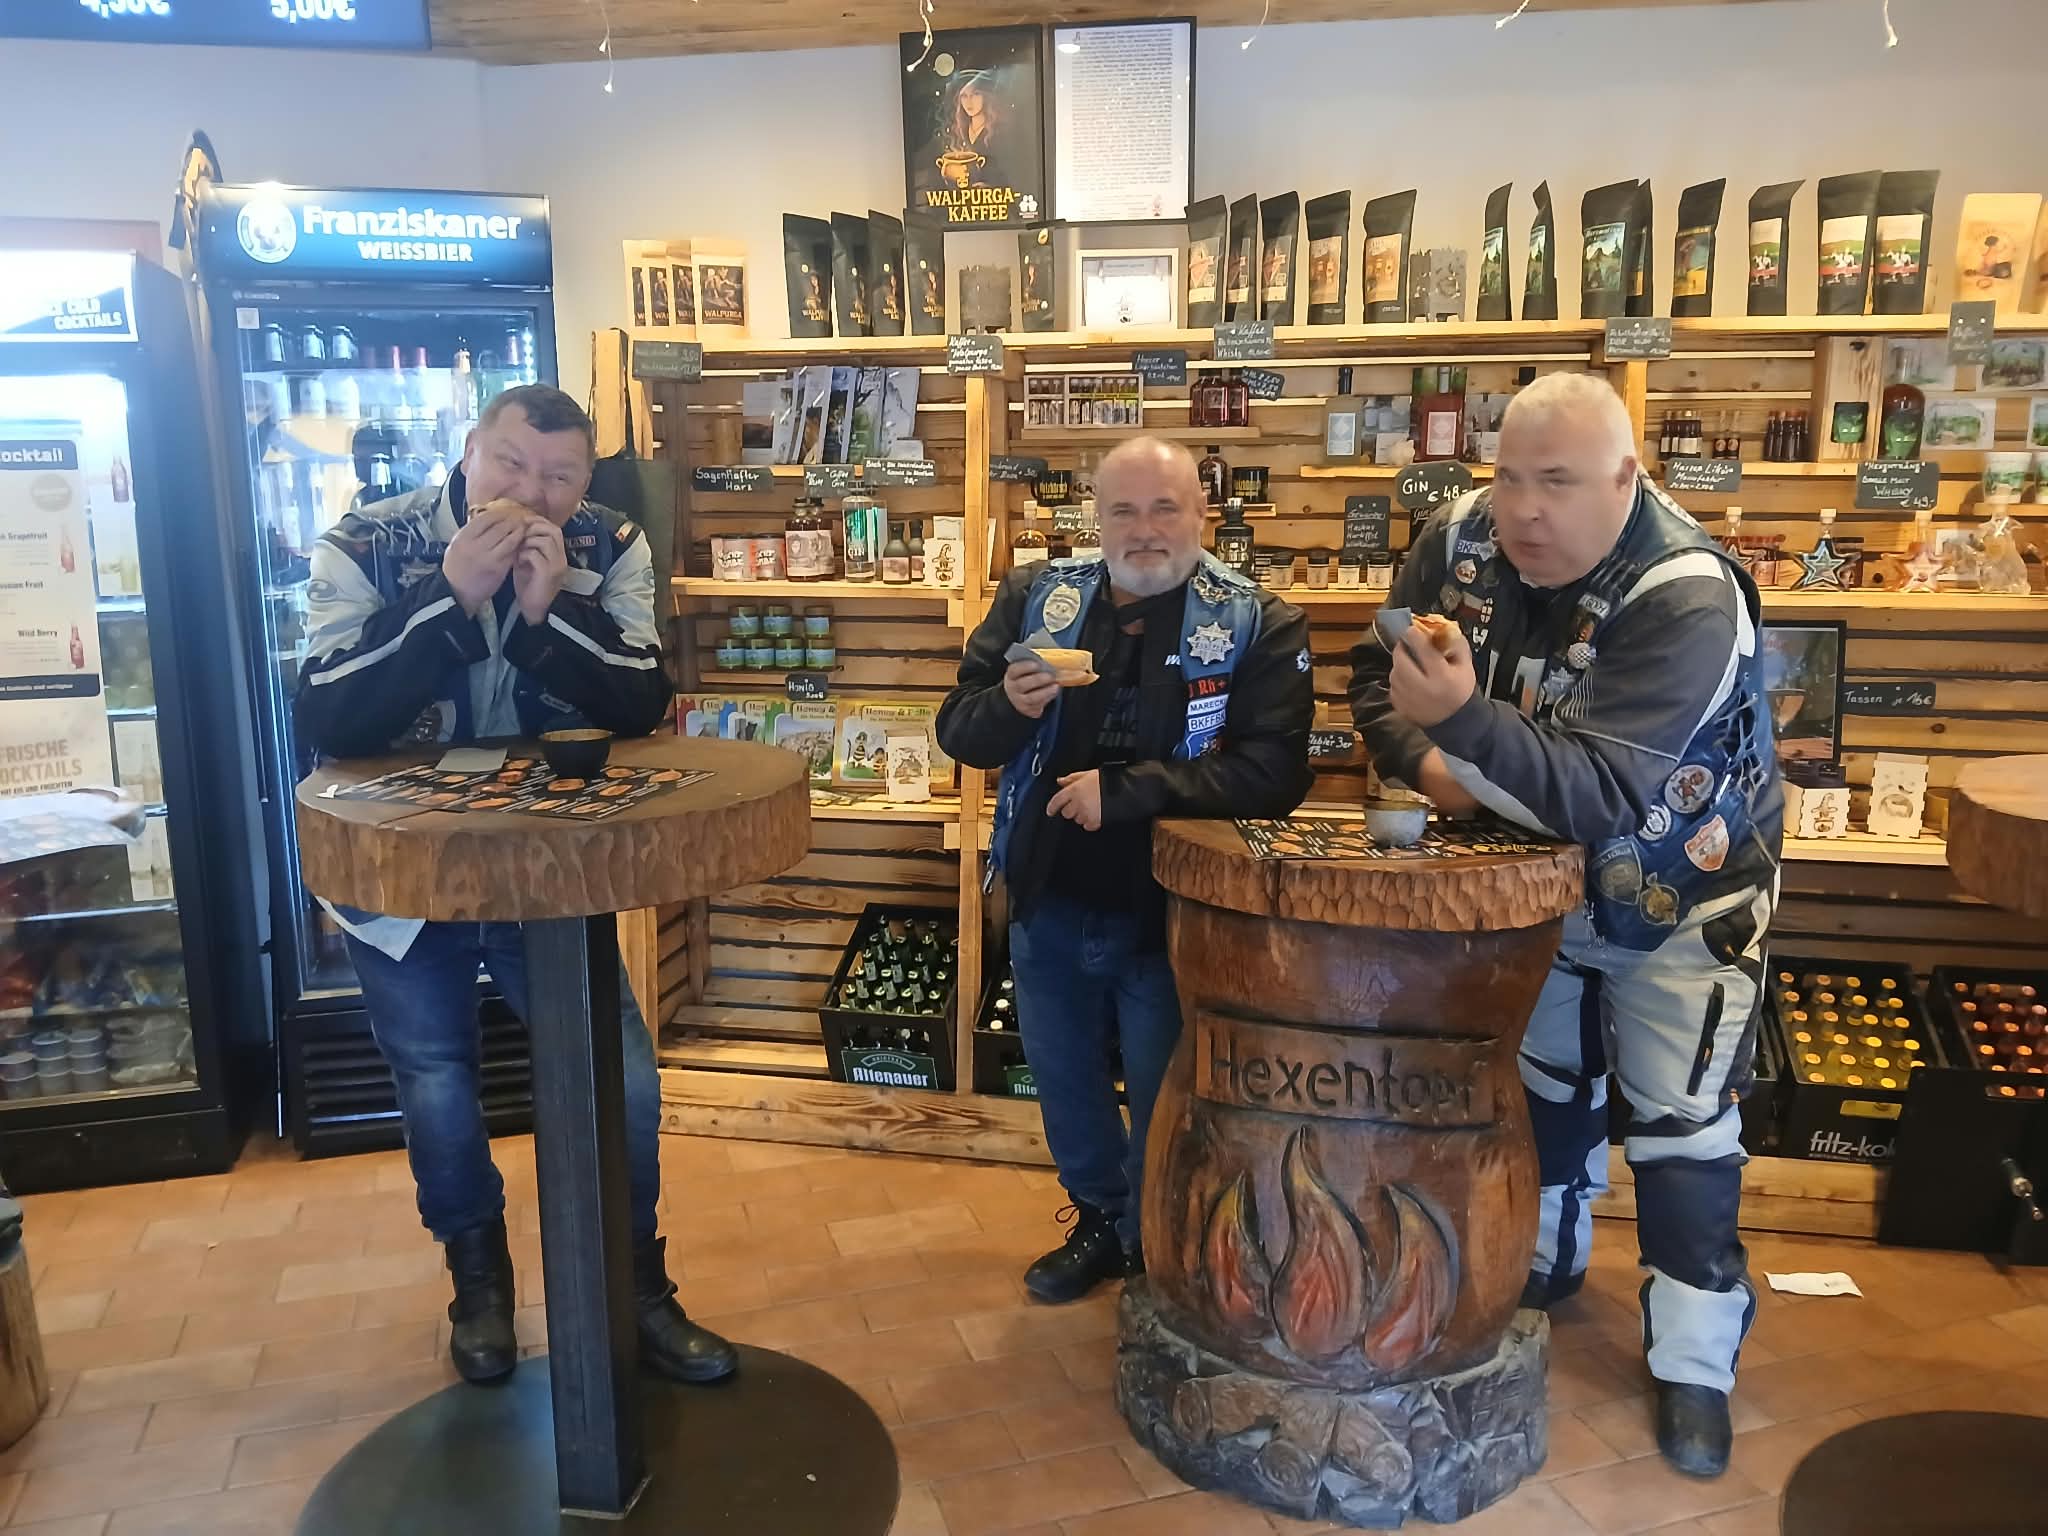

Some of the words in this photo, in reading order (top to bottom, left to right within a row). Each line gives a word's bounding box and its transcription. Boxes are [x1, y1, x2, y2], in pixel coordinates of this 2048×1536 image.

[926, 187, 1021, 206] WALPURGA-
[948, 204, 1008, 222] KAFFEE
[303, 205, 522, 240] Franziskaner
[357, 241, 473, 262] WEISSBIER
[1238, 322, 1265, 339] Kaffee
[725, 480, 753, 491] Harz
[1402, 478, 1429, 494] GIN
[1427, 491, 1439, 502] €
[8, 531, 48, 541] Grapefruit
[37, 628, 58, 638] Berry
[1844, 690, 1883, 703] Tassen
[852, 1067, 929, 1087] Altenauer
